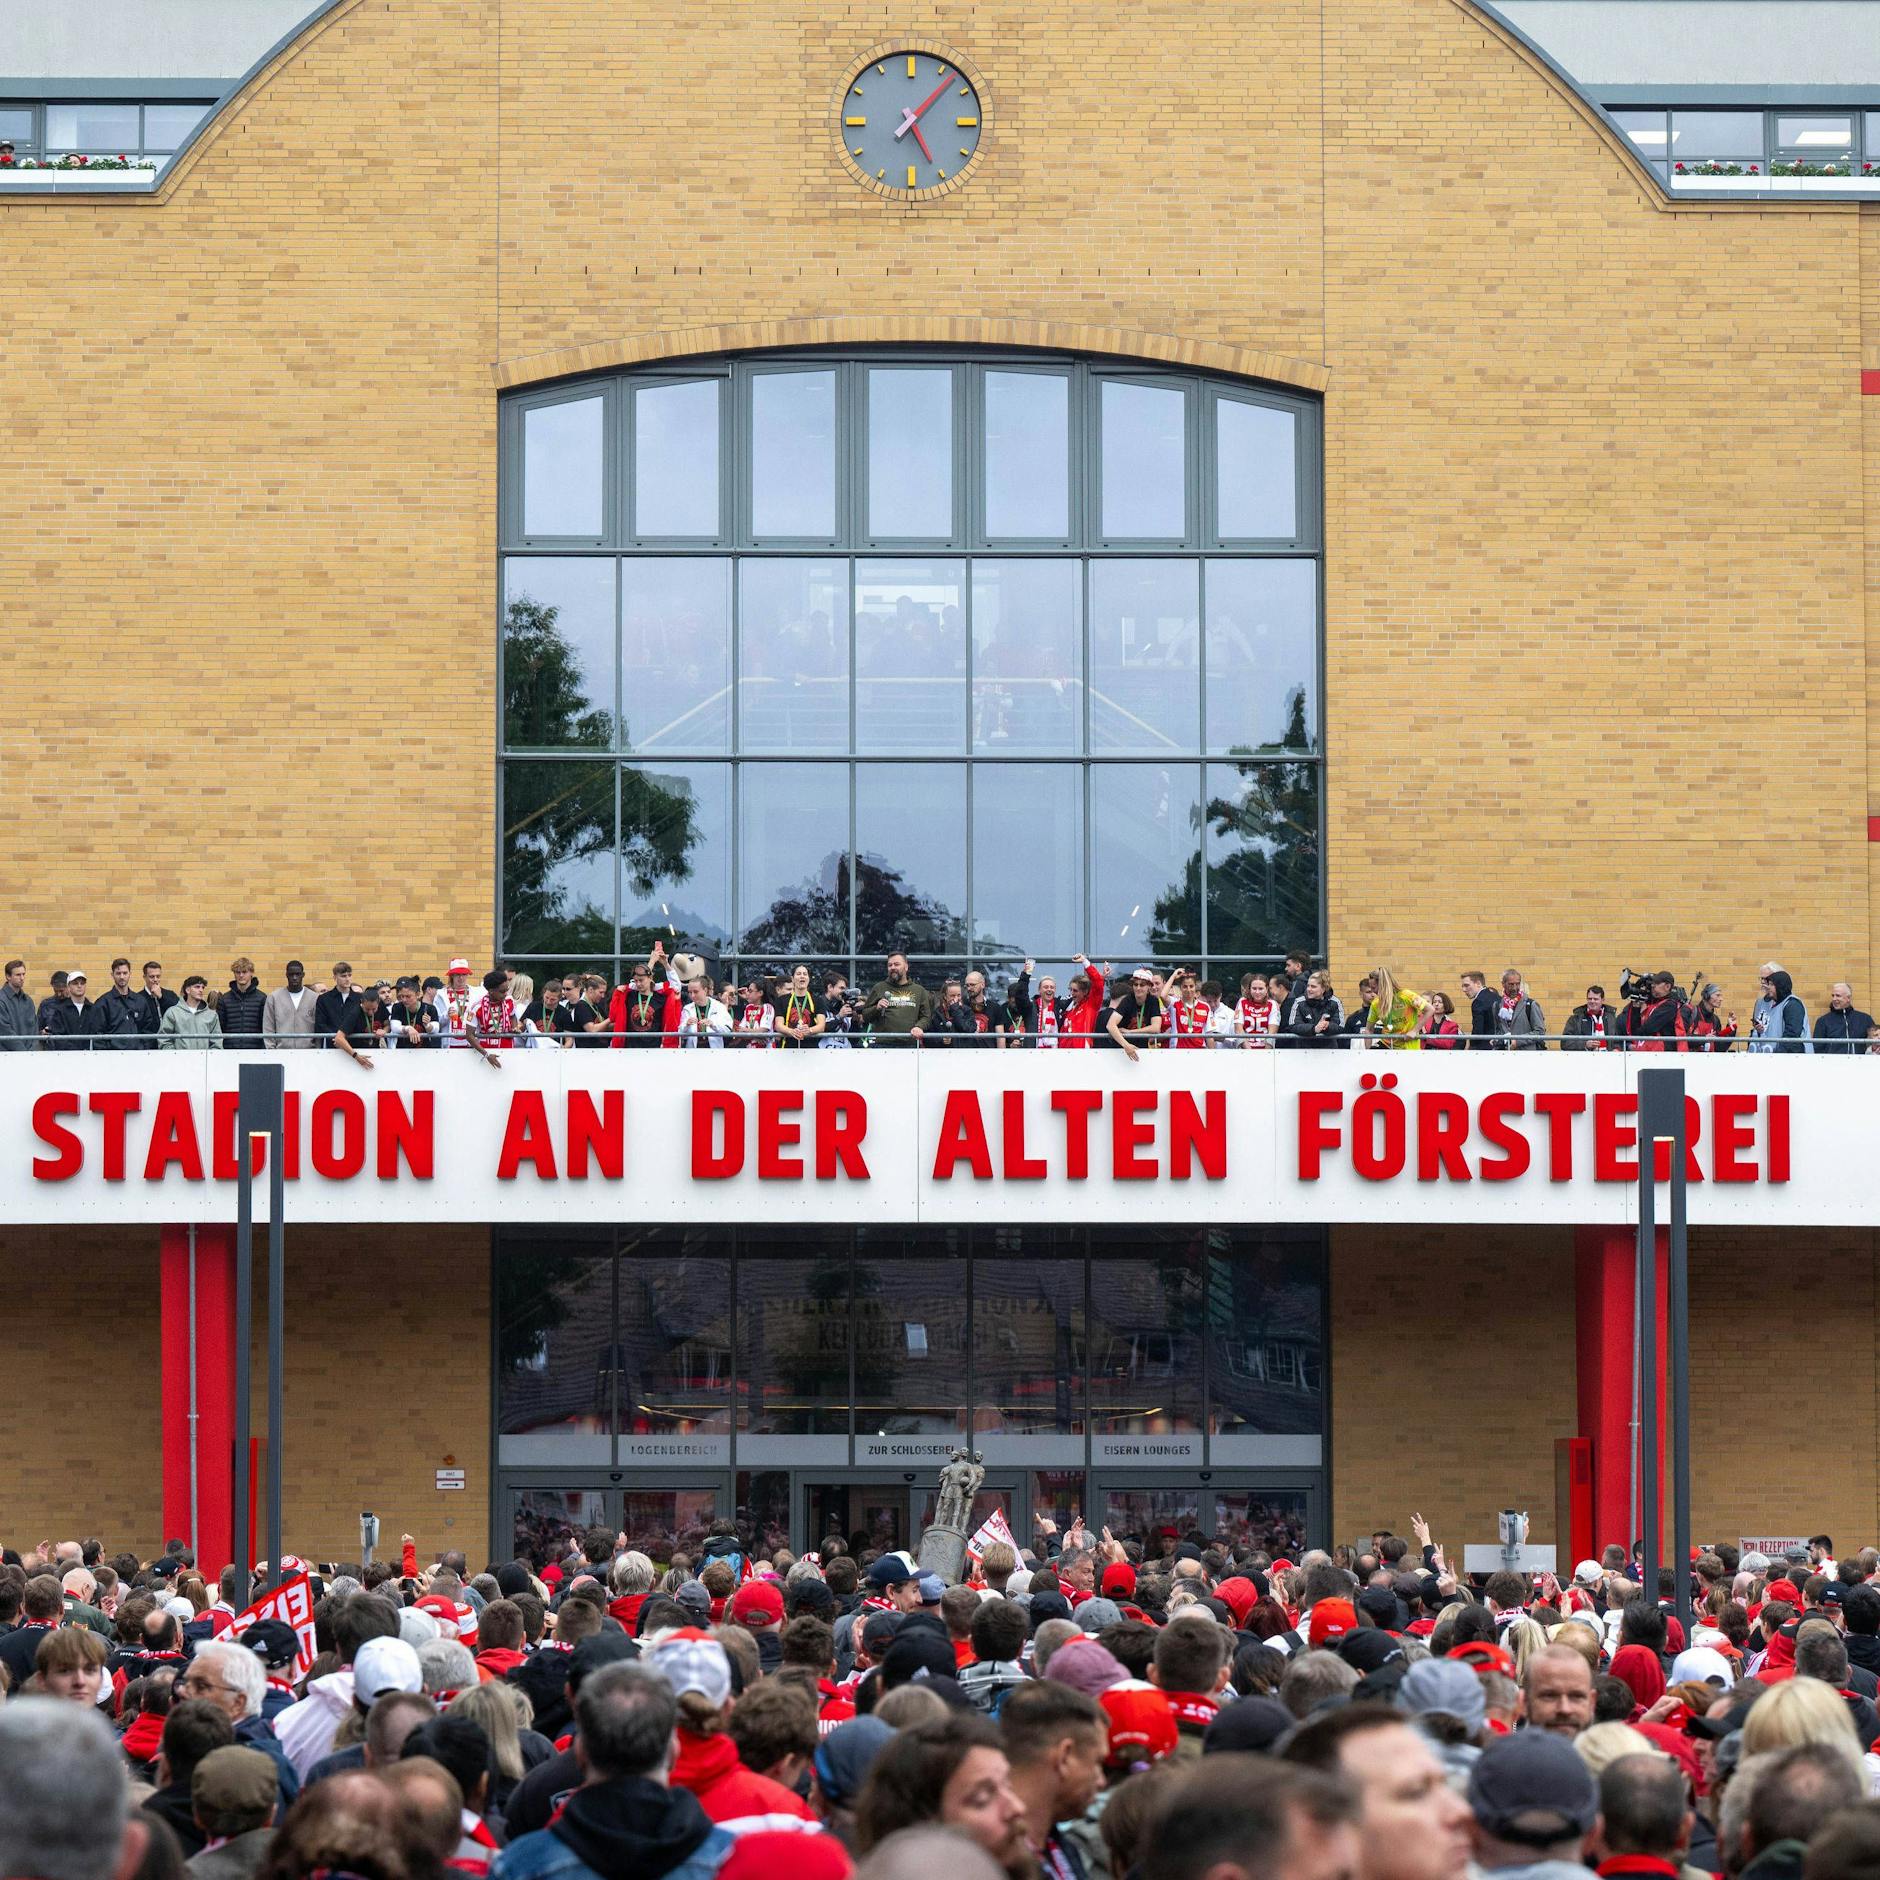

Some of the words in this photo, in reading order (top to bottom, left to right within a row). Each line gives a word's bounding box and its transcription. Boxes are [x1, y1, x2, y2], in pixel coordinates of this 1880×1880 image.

[32, 1089, 435, 1181] STADION
[496, 1089, 625, 1180] AN
[691, 1089, 871, 1180] DER
[932, 1089, 1227, 1180] ALTEN
[631, 1445, 717, 1455] LOGENBEREICH
[868, 1445, 888, 1455] ZUR
[891, 1445, 954, 1455] SCHLOSSEREI
[1104, 1445, 1140, 1455] EISERN
[1144, 1445, 1191, 1455] LOUNGES
[1759, 1541, 1799, 1553] REZEPTI
